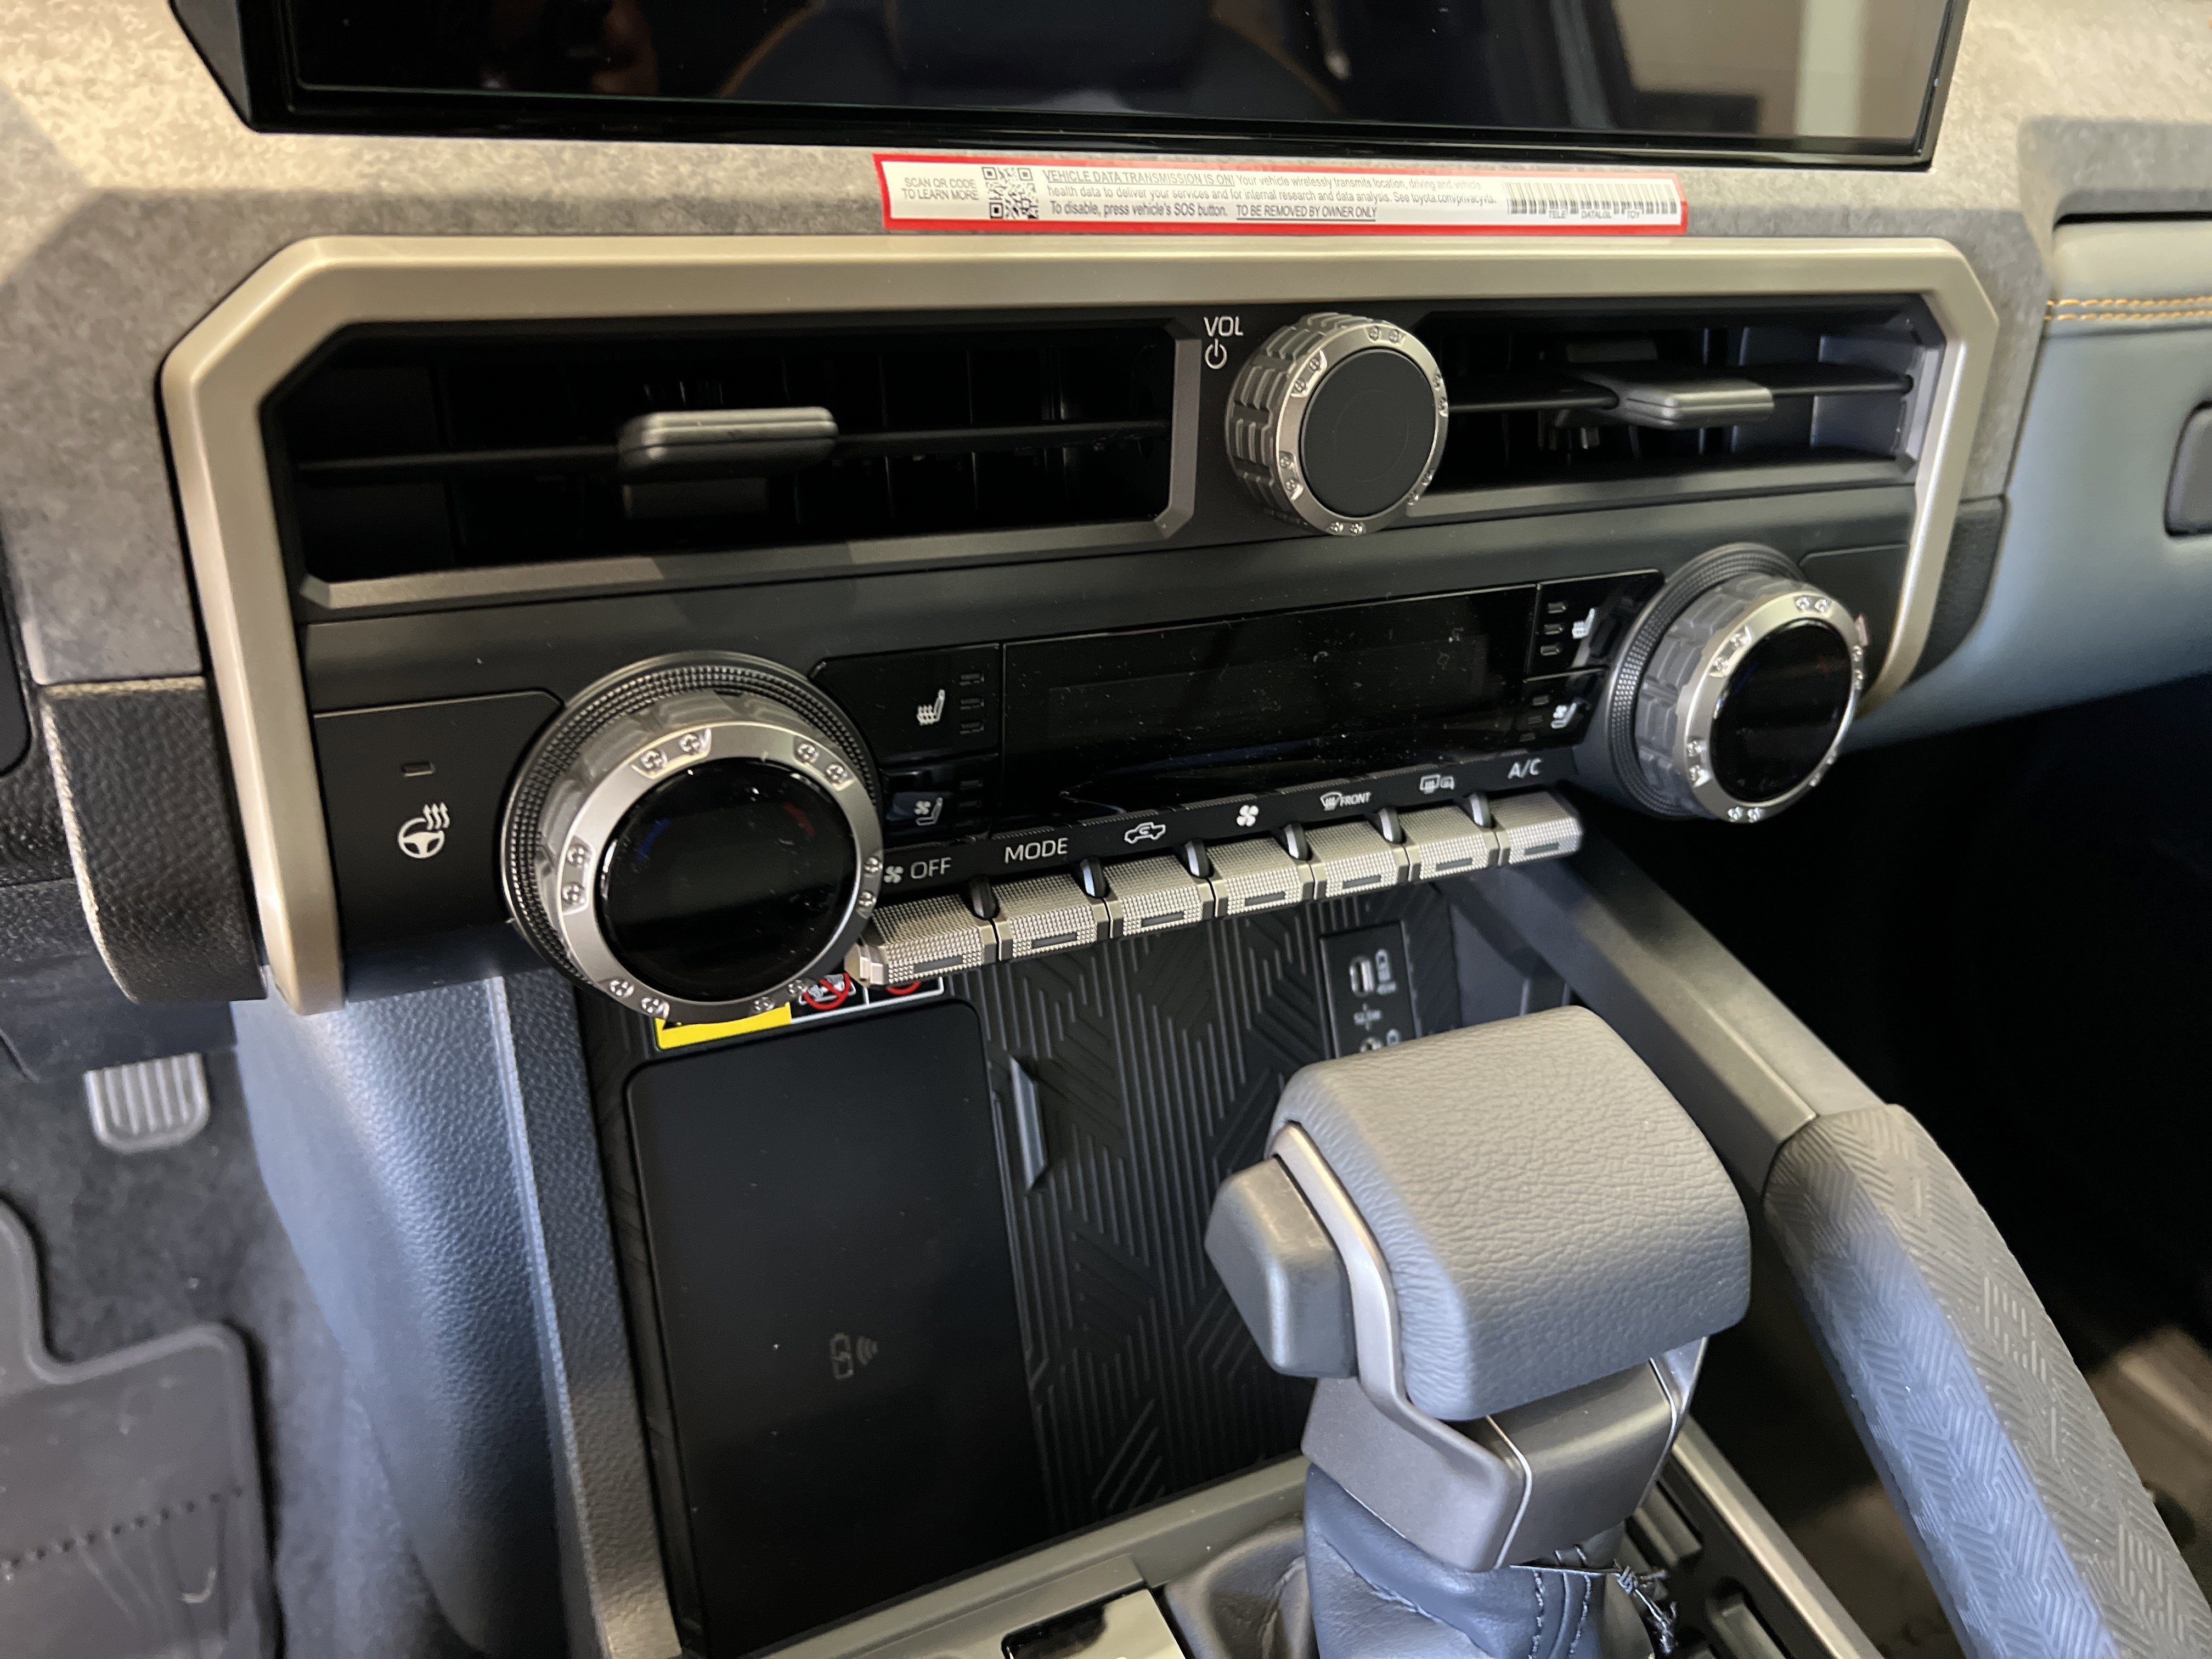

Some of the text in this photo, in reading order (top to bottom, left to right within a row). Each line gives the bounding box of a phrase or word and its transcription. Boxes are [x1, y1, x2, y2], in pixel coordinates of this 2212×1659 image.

[904, 178, 932, 188] SCAN
[950, 179, 977, 189] CODE
[1042, 170, 1091, 182] VEHICLE
[1093, 171, 1122, 183] DATA
[1122, 172, 1202, 184] TRANSMISSION
[1204, 174, 1214, 184] IS
[1236, 174, 1256, 185] Your
[1259, 176, 1289, 186] vehicle
[1291, 176, 1331, 189] wirelessly
[1334, 177, 1372, 188] transmits
[1373, 178, 1408, 189] location,
[1409, 178, 1436, 191] driving
[1437, 179, 1452, 189] and
[1455, 180, 1481, 190] vehicle
[901, 188, 979, 201] TO LEARN MORE
[1047, 185, 1078, 196] health
[1080, 186, 1101, 197] data
[1103, 187, 1113, 198] to
[1116, 187, 1146, 198] deliver
[1149, 190, 1169, 201] your
[1172, 189, 1209, 199] services
[1212, 189, 1228, 199] and
[1230, 189, 1242, 200] for
[1244, 189, 1277, 200] internal
[1279, 190, 1316, 201] research
[1318, 191, 1334, 201] and
[1336, 191, 1355, 201] data
[1356, 191, 1392, 204] analysis.
[1393, 191, 1410, 202] See
[1050, 200, 1228, 218] To disable, press vehicle's SOS button.
[1236, 205, 1377, 218] TO BE REMOVED BY OWNER ONLY
[1204, 316, 1244, 337] VOL
[1508, 758, 1542, 779] A/C
[1339, 792, 1372, 807] FRONT
[1005, 837, 1069, 864] MODE
[910, 857, 952, 879] OFF
